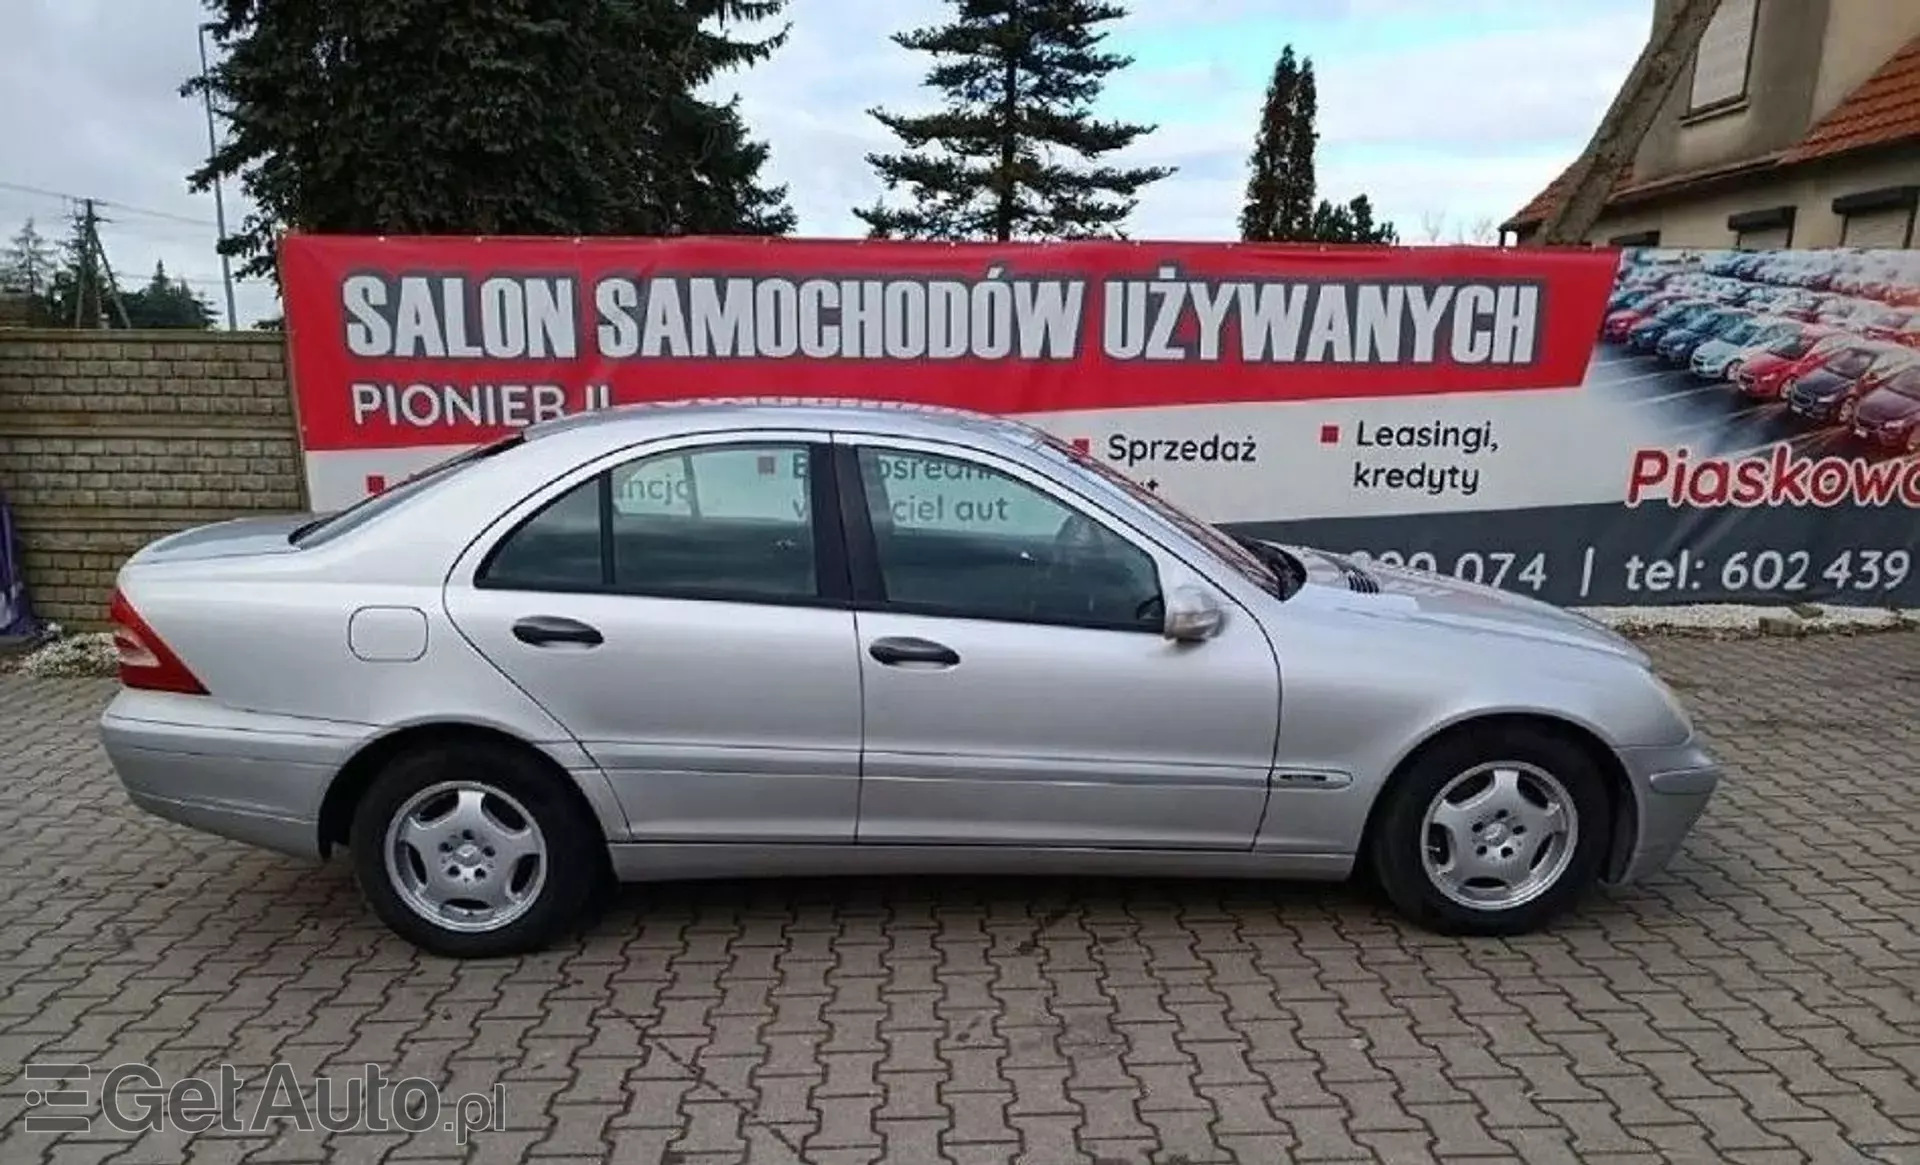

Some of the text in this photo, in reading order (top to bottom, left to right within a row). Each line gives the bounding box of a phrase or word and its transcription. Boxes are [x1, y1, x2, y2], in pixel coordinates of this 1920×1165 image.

[343, 266, 1541, 364] SALON SAMOCHODÓW UŻYWANYCH
[351, 383, 565, 428] PIONIER
[1107, 433, 1257, 468] Sprzedaż
[1356, 420, 1500, 453] Leasingi,
[1353, 462, 1479, 495] kredyty
[955, 497, 1009, 522] aut
[1454, 552, 1547, 591] 074
[1625, 550, 1704, 590] tel:
[1721, 550, 1810, 590] 602
[1823, 550, 1911, 590] 439
